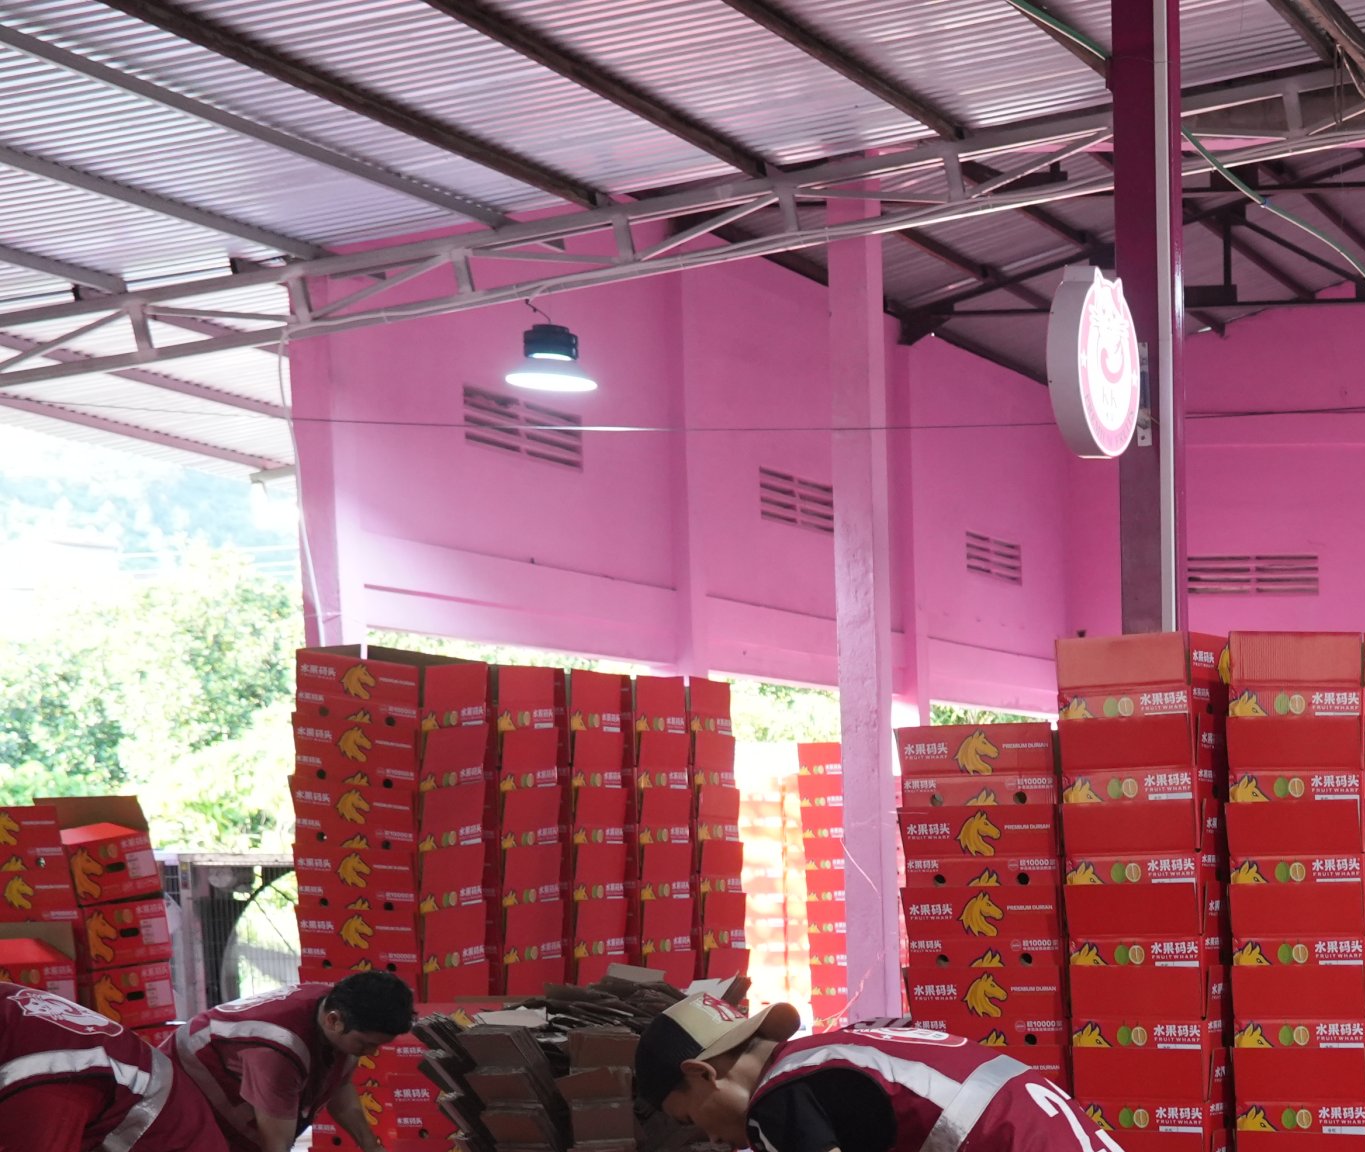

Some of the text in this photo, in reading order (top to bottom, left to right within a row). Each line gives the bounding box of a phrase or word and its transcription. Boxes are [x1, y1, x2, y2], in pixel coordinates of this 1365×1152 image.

[1140, 691, 1187, 705] 水果码头
[1312, 693, 1359, 705] 水果码头
[904, 744, 948, 755] 水果码头
[1144, 774, 1191, 786] 水果码头
[1311, 775, 1359, 787] 水果码头
[907, 824, 950, 835] 水果码头
[1148, 859, 1195, 871] 水果码头
[1312, 859, 1360, 871] 水果码头
[909, 904, 952, 916] 水果码头
[1151, 942, 1198, 954] 水果码头
[1315, 941, 1362, 953] 水果码头
[914, 985, 957, 996] 水果码头
[1154, 1025, 1200, 1036] 水果码头
[1316, 1024, 1364, 1035] 水果码头
[1156, 1107, 1202, 1119] 水果码头
[1319, 1107, 1365, 1119] 水果码头
